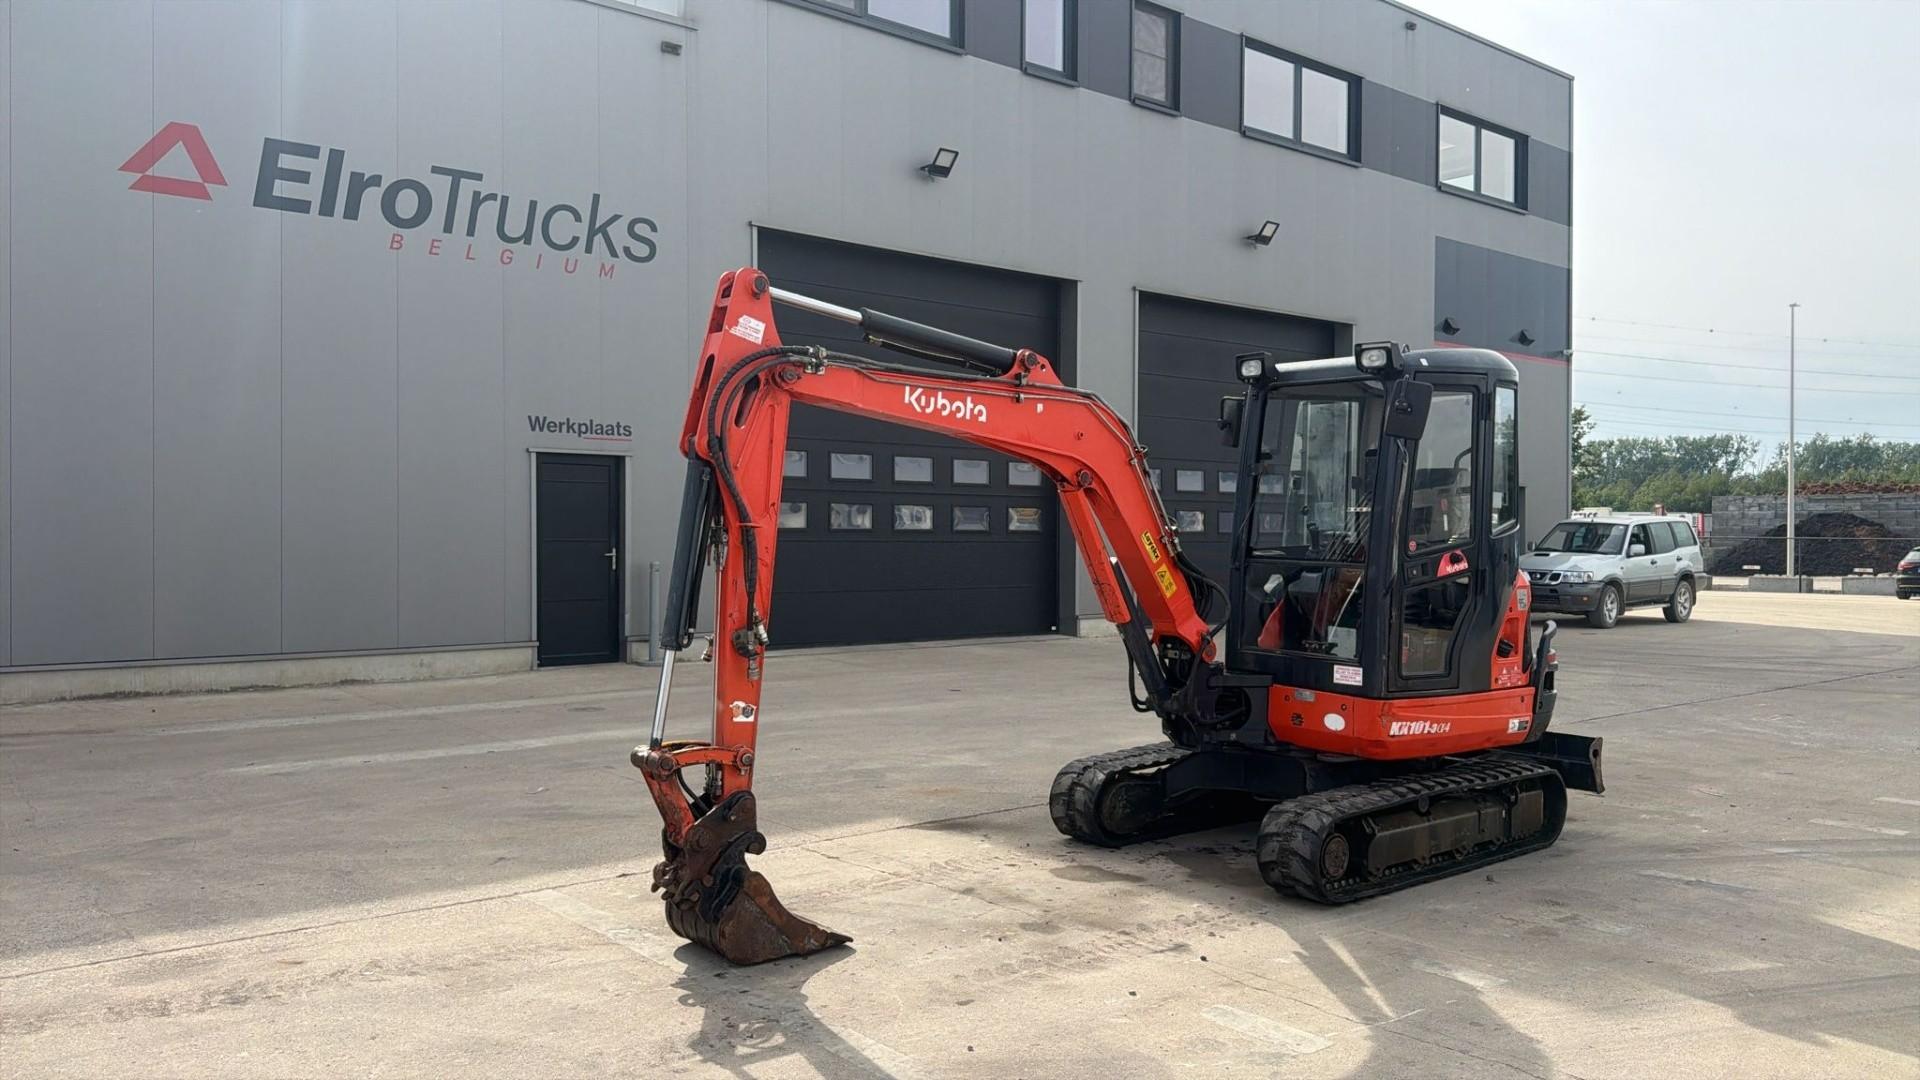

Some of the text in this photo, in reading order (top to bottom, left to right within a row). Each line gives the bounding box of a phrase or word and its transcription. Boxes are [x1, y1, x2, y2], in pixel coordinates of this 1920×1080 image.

[253, 137, 658, 263] ElroTrucks
[389, 233, 615, 280] BELGIUM
[904, 385, 987, 422] Kubota
[528, 415, 632, 437] Werkplaats
